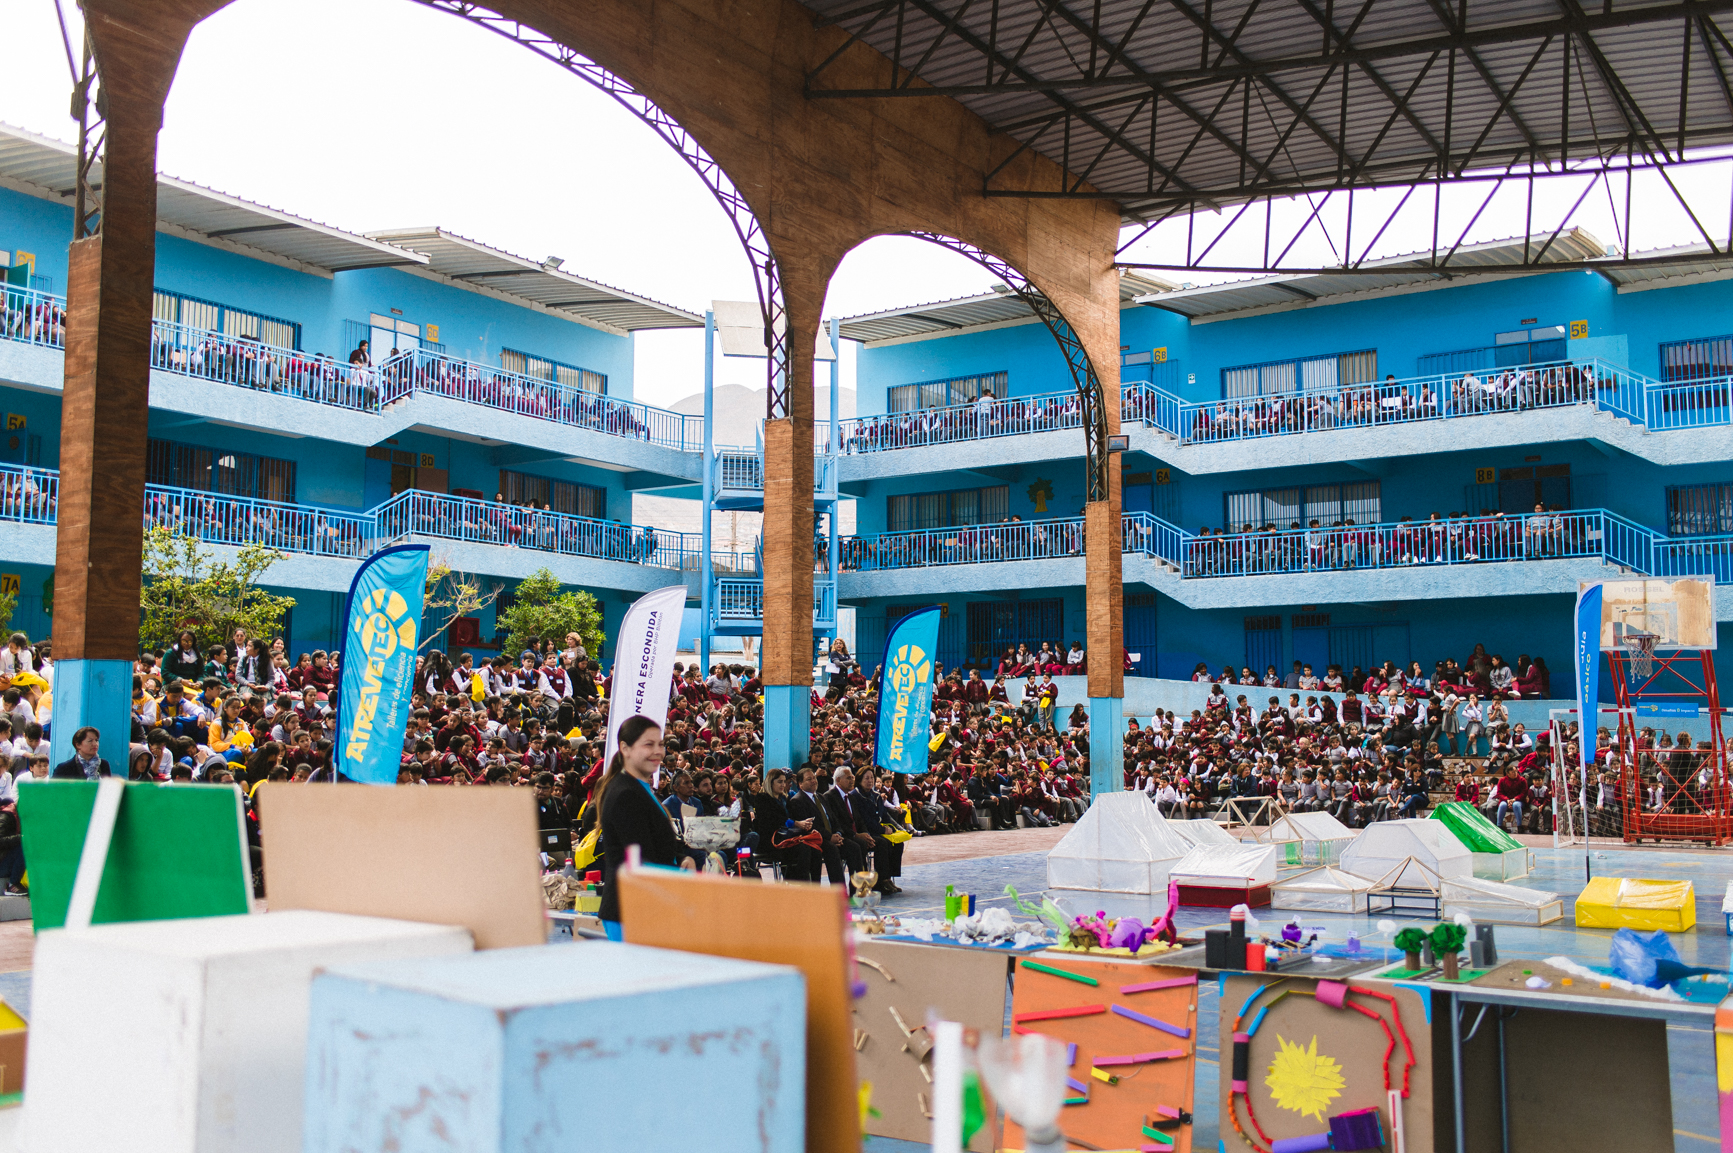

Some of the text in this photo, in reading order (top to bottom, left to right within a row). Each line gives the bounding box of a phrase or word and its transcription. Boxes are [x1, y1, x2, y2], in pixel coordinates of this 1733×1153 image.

[427, 326, 438, 338] 6D
[1571, 324, 1587, 337] 5B
[1154, 350, 1167, 362] 6B
[421, 454, 434, 467] 8D
[1157, 471, 1169, 482] 6A
[1477, 470, 1493, 482] 8B
[3, 576, 19, 592] 7A
[634, 610, 658, 714] NERA ESCONDIDA
[647, 654, 656, 679] Operada
[345, 614, 391, 763] ATREVETEC
[386, 651, 407, 729] Talleres de eficiencia
[889, 666, 911, 762] ATREVETEC
